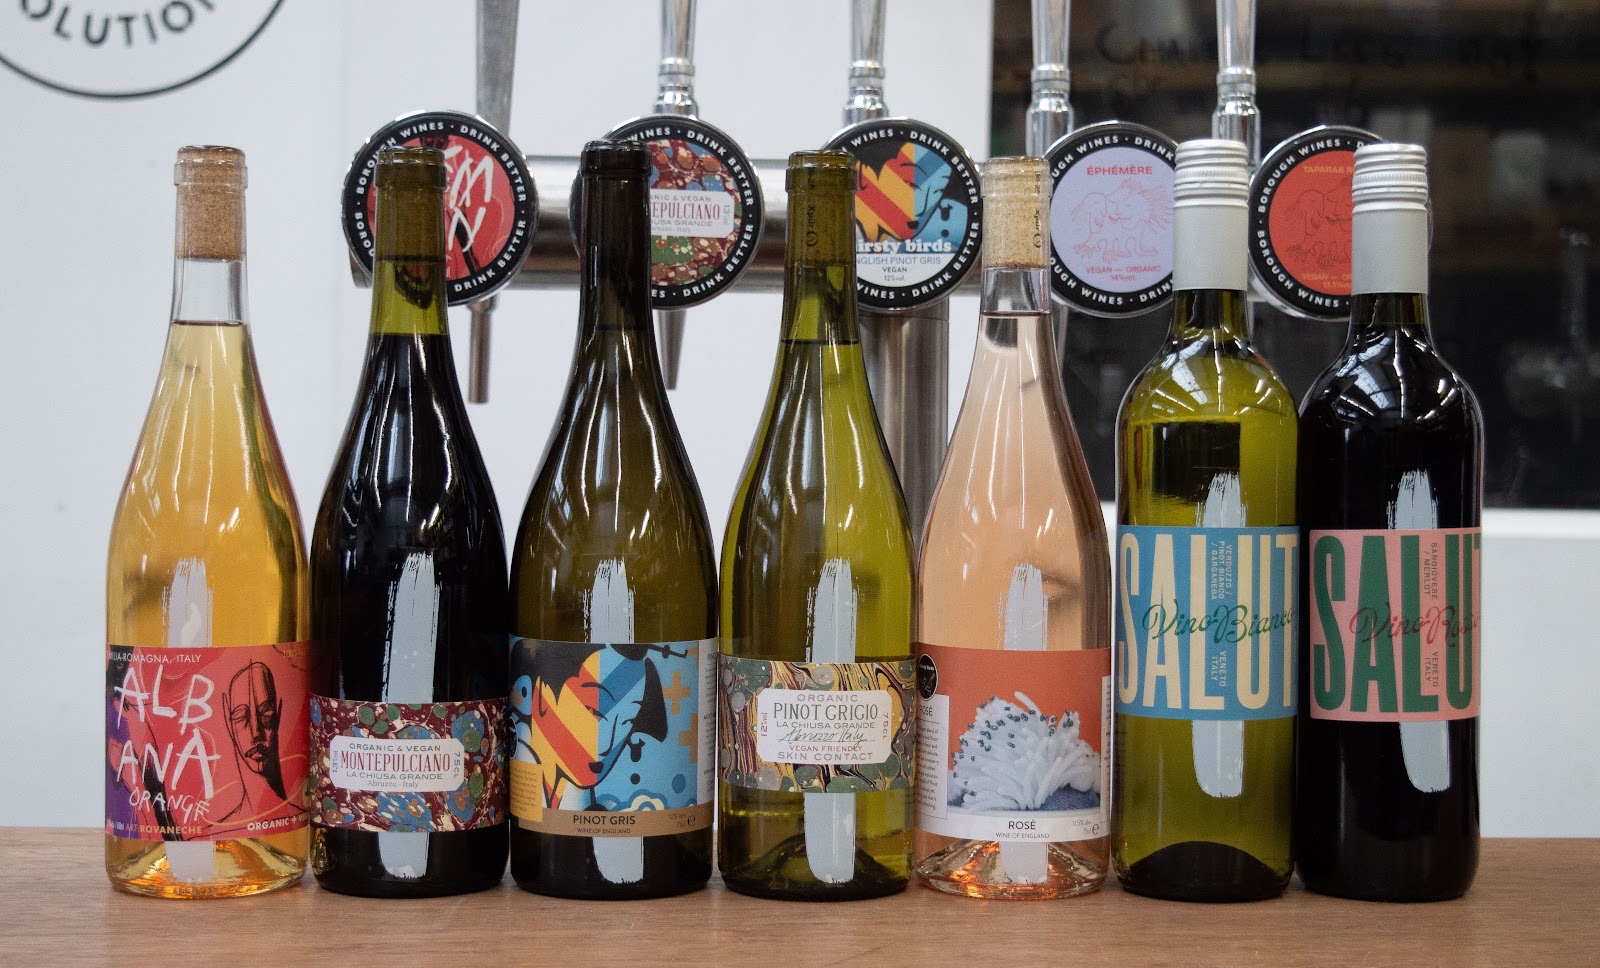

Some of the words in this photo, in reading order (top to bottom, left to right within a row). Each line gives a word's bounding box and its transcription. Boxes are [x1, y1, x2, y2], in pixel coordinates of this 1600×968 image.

[20, 0, 215, 48] OLUTIO
[400, 121, 445, 140] WINES
[460, 124, 500, 151] DRINK
[501, 153, 527, 203] BETTER
[1077, 134, 1120, 155] WINES
[1134, 137, 1176, 162] DRINK
[627, 126, 671, 143] WINES
[687, 130, 727, 157] DRINK
[727, 156, 755, 206] BETTER
[850, 128, 894, 147] WINES
[909, 130, 950, 158] DRINK
[950, 156, 979, 205] BETTER
[1257, 155, 1297, 214] BOROUGH
[1298, 138, 1341, 157] WINES
[652, 201, 720, 221] EPULCIANO
[675, 220, 713, 228] GRANDE
[355, 211, 375, 258] BOROU
[454, 270, 495, 292] DRINK
[497, 219, 527, 269] BETTER
[683, 273, 725, 298] DRINK
[726, 223, 755, 273] BETTER
[855, 256, 888, 265] NGLISH
[890, 256, 917, 265] PINOT
[919, 257, 941, 265] GRIS
[856, 239, 900, 256] irsty
[905, 238, 953, 254] birds
[911, 272, 953, 298] DRINK
[953, 221, 980, 272] BETTER
[1257, 230, 1295, 291] BOROUGH
[1297, 287, 1340, 308] WINES
[1080, 287, 1123, 306] WINES
[1139, 279, 1174, 302] DRIN
[1218, 540, 1226, 566] PINOT
[1225, 544, 1233, 589] VERDUZZO
[1210, 549, 1218, 600] GARGANEGA
[1218, 568, 1226, 599] BIANCO
[1423, 558, 1431, 596] MERLOT
[1430, 542, 1439, 600] SANGIOVESE
[1118, 532, 1297, 710] SALUT
[1142, 599, 1217, 640] Vino
[1349, 601, 1430, 644] Vino
[176, 654, 203, 663] ITALY
[1219, 650, 1227, 687] VENETO
[1424, 657, 1432, 682] ITALY
[1431, 651, 1439, 688] VENETO
[114, 664, 215, 735] ALB
[773, 703, 822, 720] PINOT
[825, 704, 878, 720] GRIGIO
[797, 693, 858, 703] ORGANIC
[778, 728, 838, 743] Abruzzo
[791, 721, 831, 729] CHIUSA
[833, 721, 876, 729] GRANDE
[340, 750, 450, 772] MONTEPULCIANO
[349, 743, 394, 751] ORGANIC
[405, 744, 441, 752] VEGAN
[777, 751, 807, 761] SKIN
[815, 752, 873, 761] CONTACT
[821, 744, 863, 752] FRIENDLY
[117, 727, 222, 799] ANA
[359, 771, 398, 780] CHIUSA
[399, 773, 443, 781] GRANDE
[367, 780, 398, 788] Abruzzo
[402, 780, 420, 789] Italy
[129, 786, 210, 825] ORANGE
[573, 814, 606, 825] PINOT
[609, 815, 636, 825] GRIS
[139, 824, 203, 835] ROVANECHE
[247, 817, 290, 831] ORGANIC
[1008, 818, 1036, 830] ROSÉ
